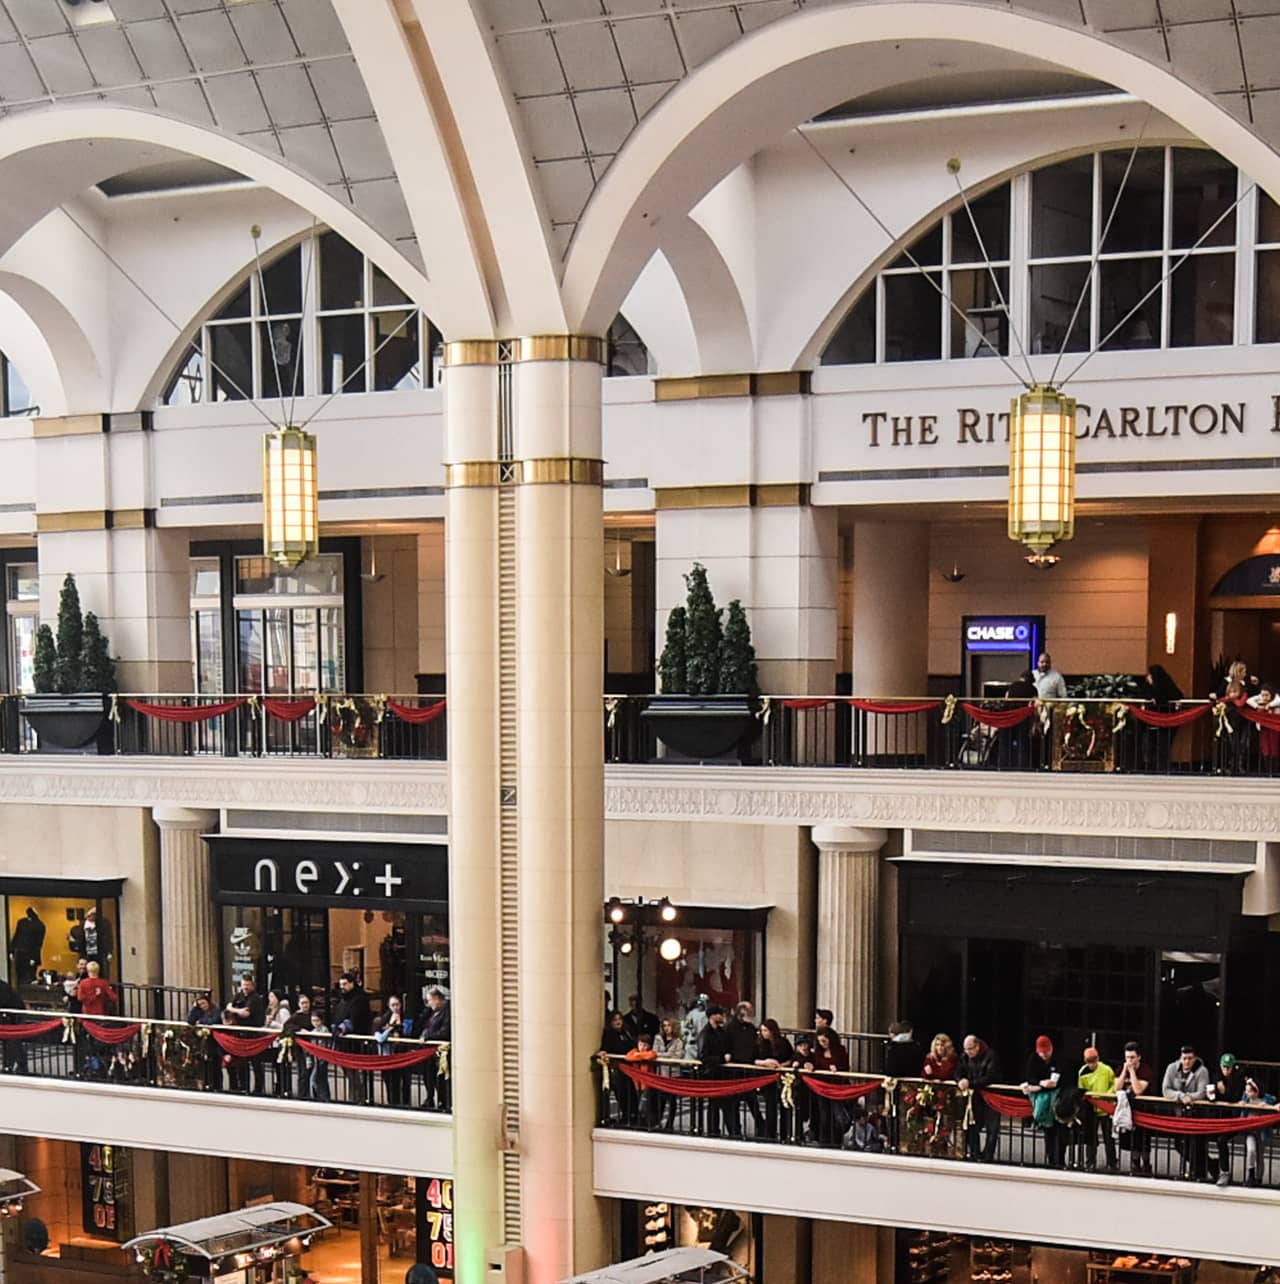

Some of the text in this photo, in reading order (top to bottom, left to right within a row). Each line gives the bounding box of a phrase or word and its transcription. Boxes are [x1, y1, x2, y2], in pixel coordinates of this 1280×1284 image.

[861, 412, 939, 447] THE
[956, 408, 1011, 444] RIT
[967, 626, 1015, 640] CHASE
